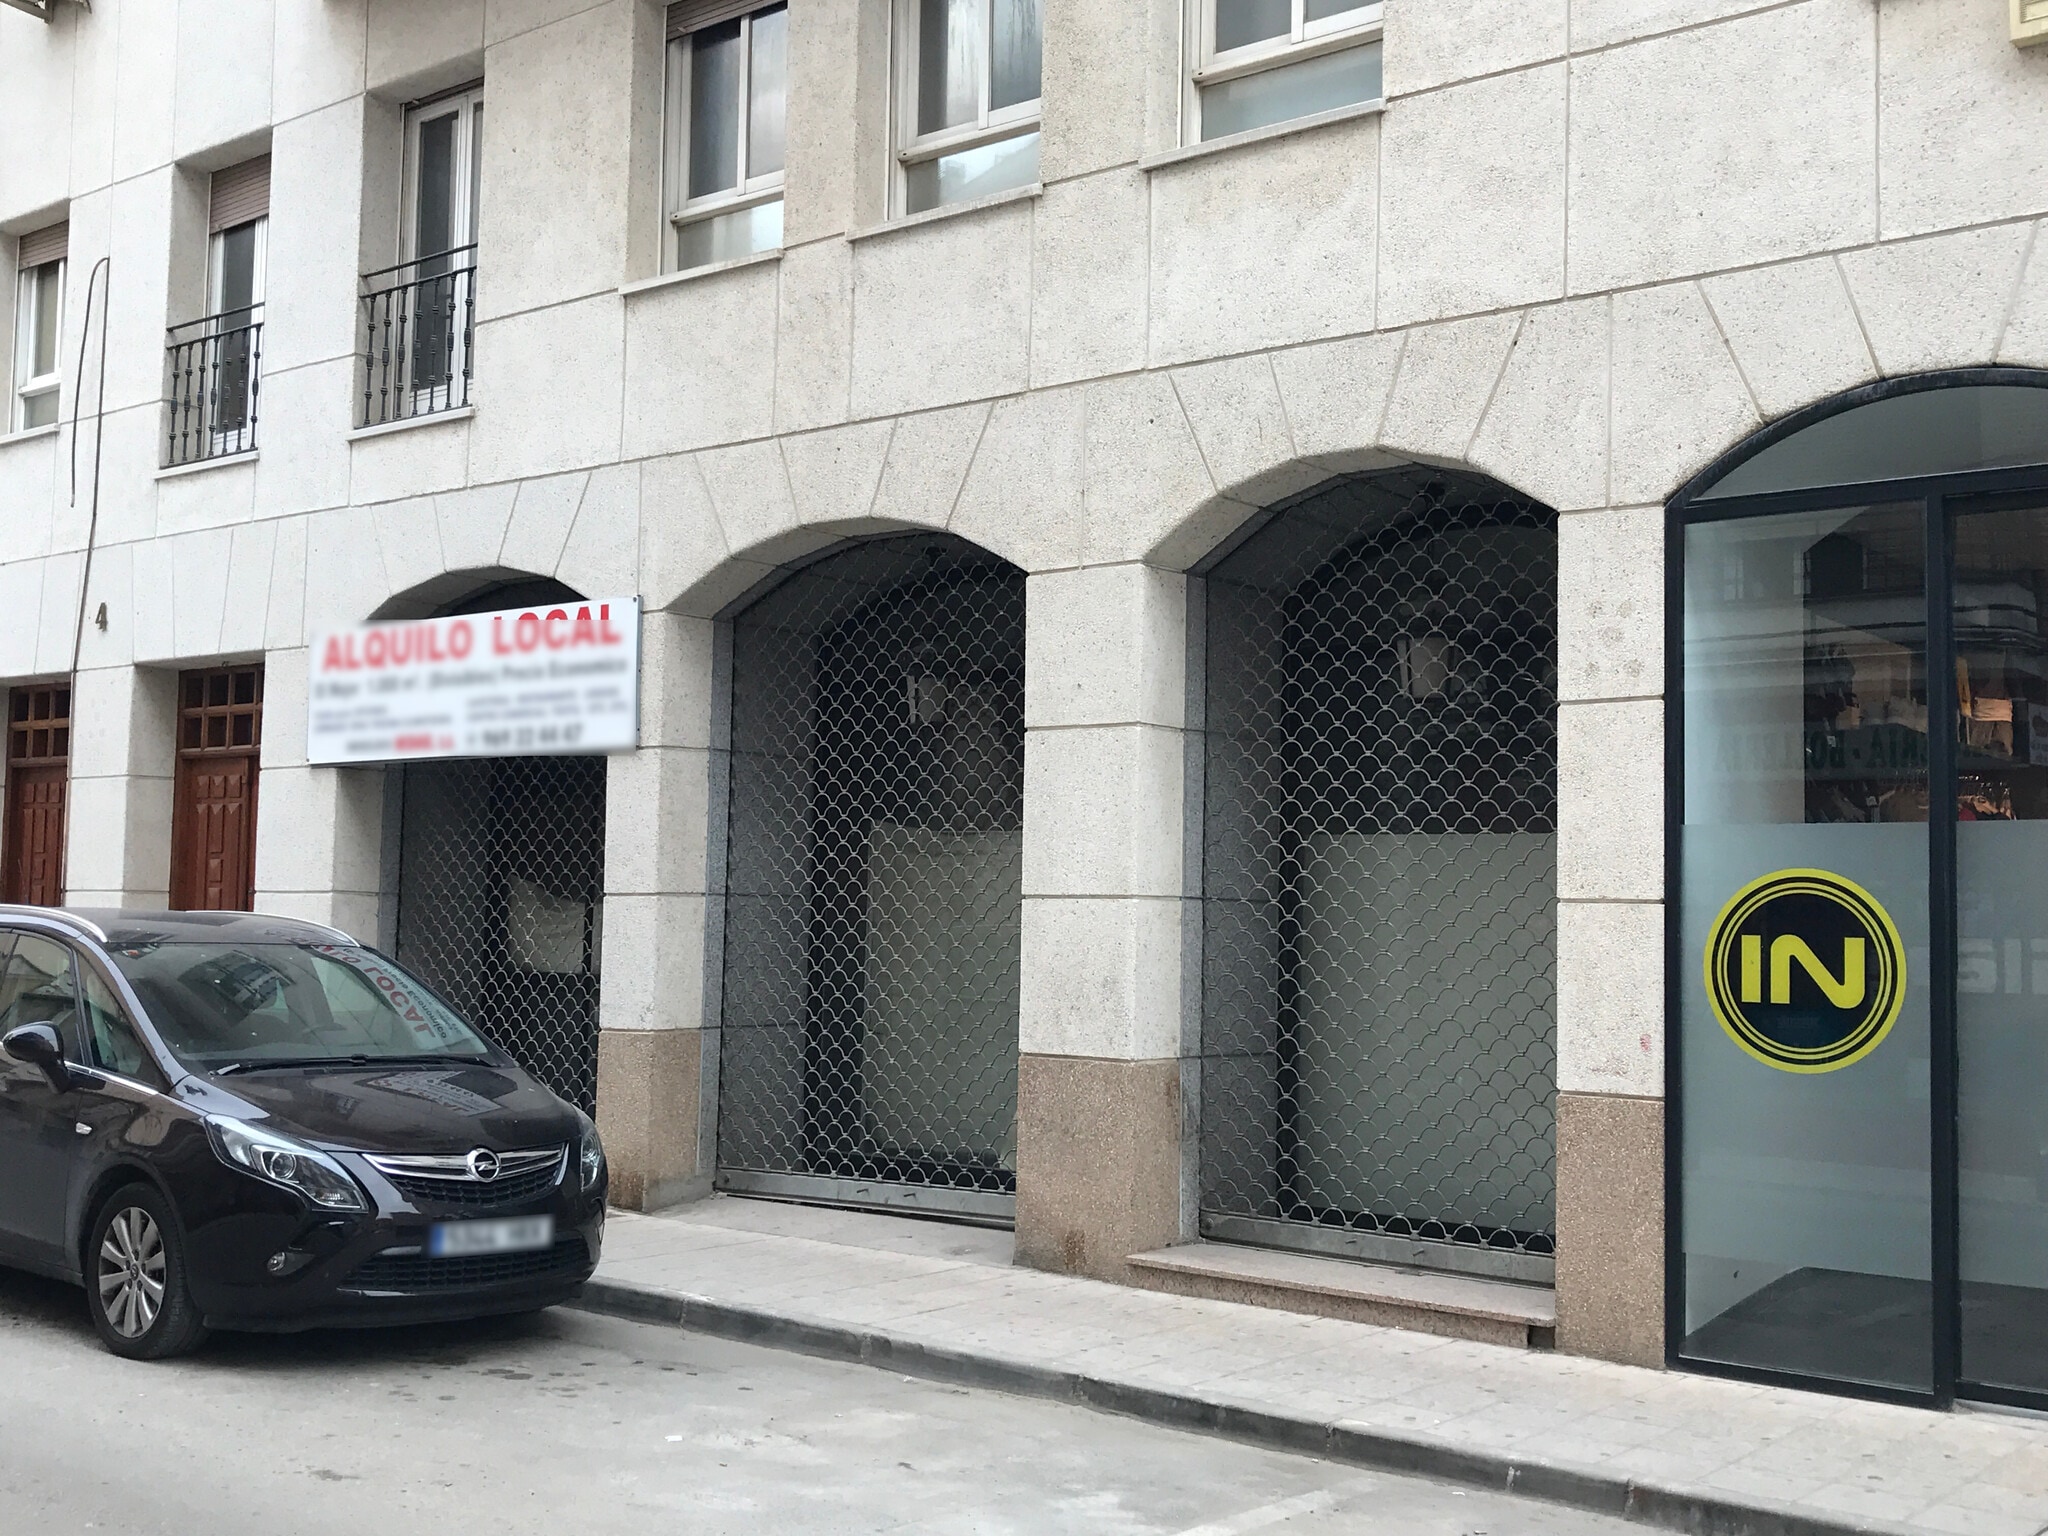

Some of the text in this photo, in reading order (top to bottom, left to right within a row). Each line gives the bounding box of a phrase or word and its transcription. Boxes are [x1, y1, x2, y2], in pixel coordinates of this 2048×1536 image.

[95, 602, 108, 632] 4
[323, 604, 622, 671] ALQUILO LOCAL
[1741, 934, 1865, 1009] IN
